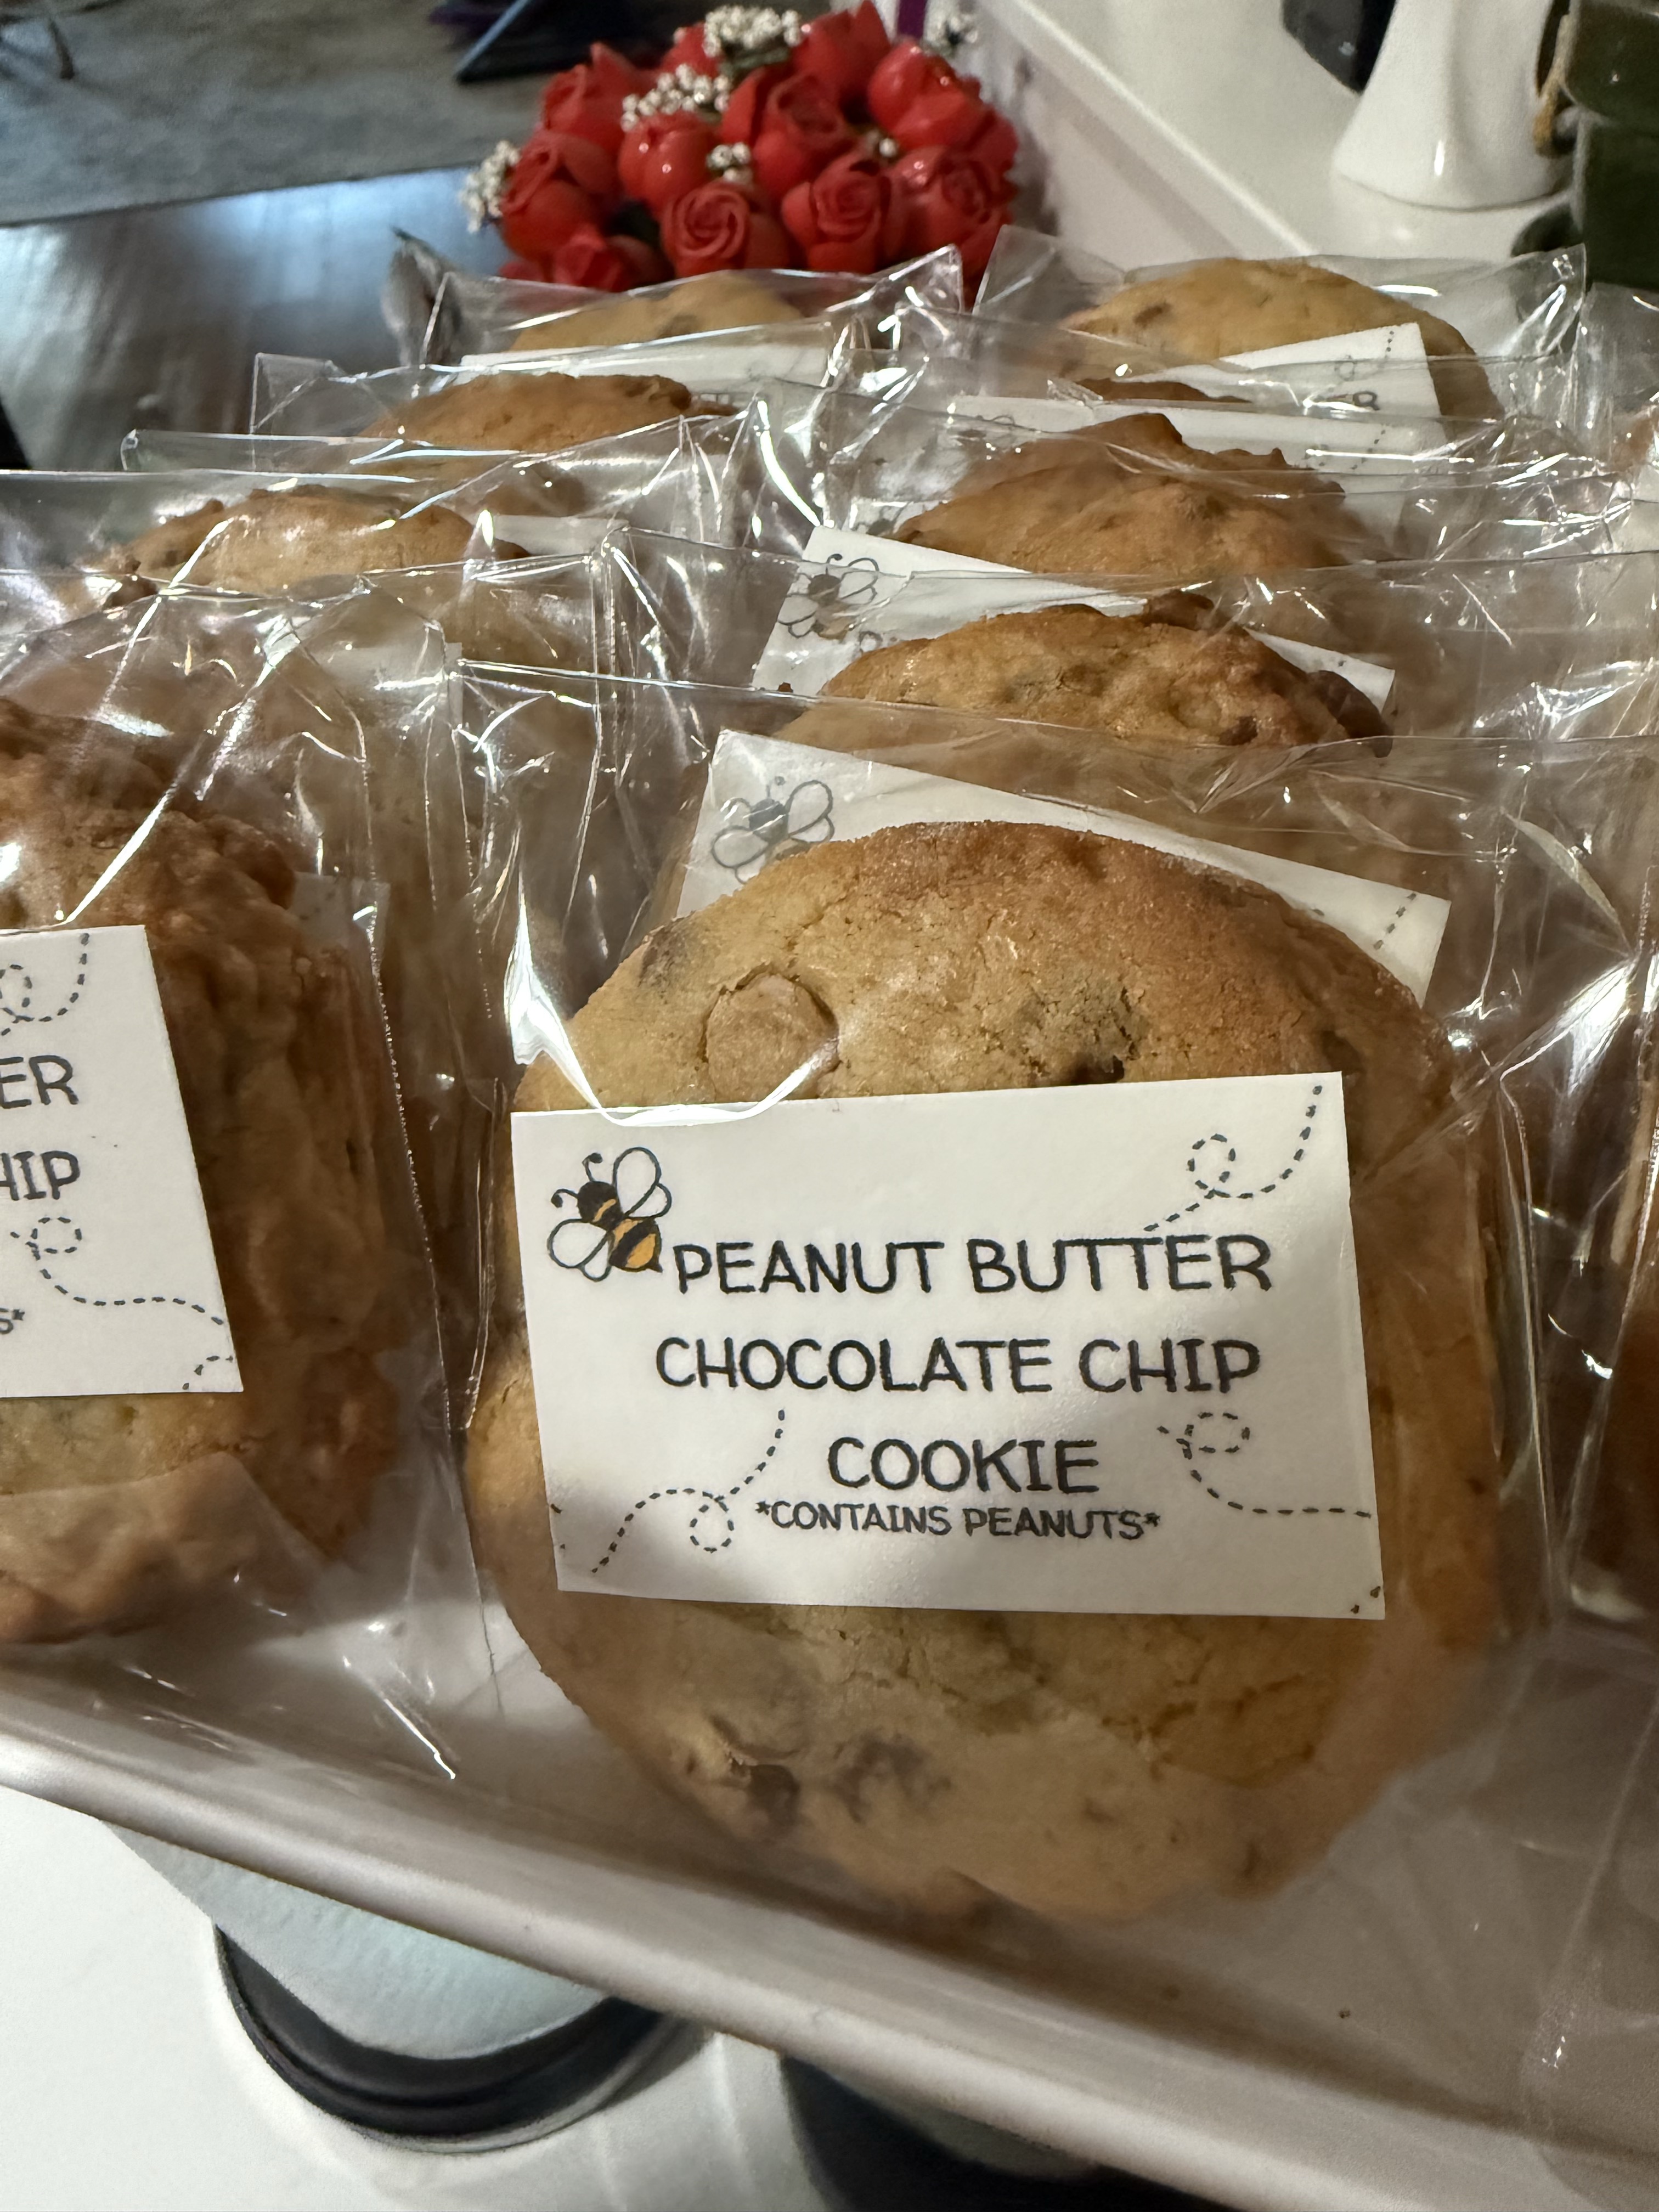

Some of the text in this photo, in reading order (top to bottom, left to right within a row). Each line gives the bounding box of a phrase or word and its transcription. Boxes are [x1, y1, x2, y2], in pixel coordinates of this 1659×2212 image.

[672, 1234, 1272, 1295] PEANUT BUTTER
[656, 1336, 1261, 1394] CHOCOLATE CHIP
[826, 1436, 1099, 1495] COOKIE
